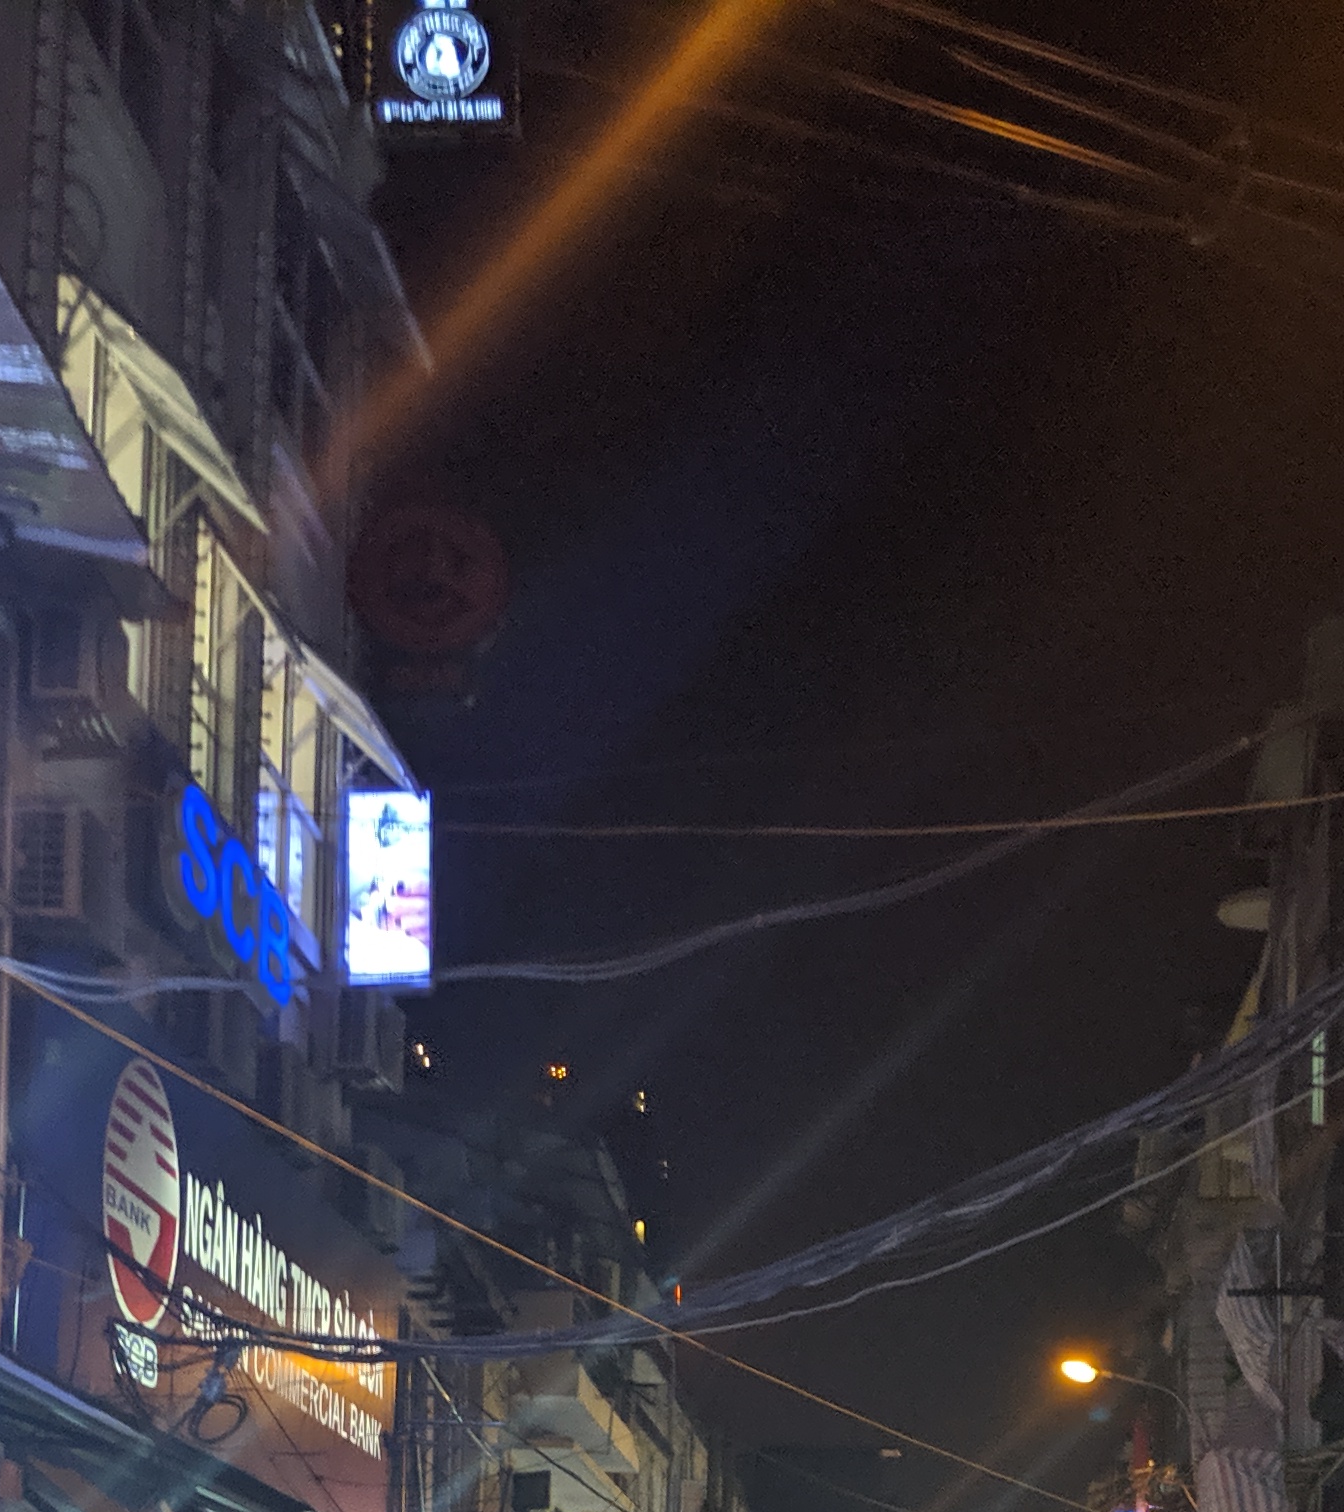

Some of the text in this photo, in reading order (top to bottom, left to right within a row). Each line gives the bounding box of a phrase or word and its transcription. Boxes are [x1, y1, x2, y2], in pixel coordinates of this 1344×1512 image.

[180, 783, 291, 1006] SCB
[106, 1183, 152, 1237] BANK
[184, 1171, 239, 1292] NGÂN
[240, 1212, 288, 1328] HÀNG
[254, 1344, 348, 1440] COMMERCIAL
[350, 1402, 383, 1461] BANK
